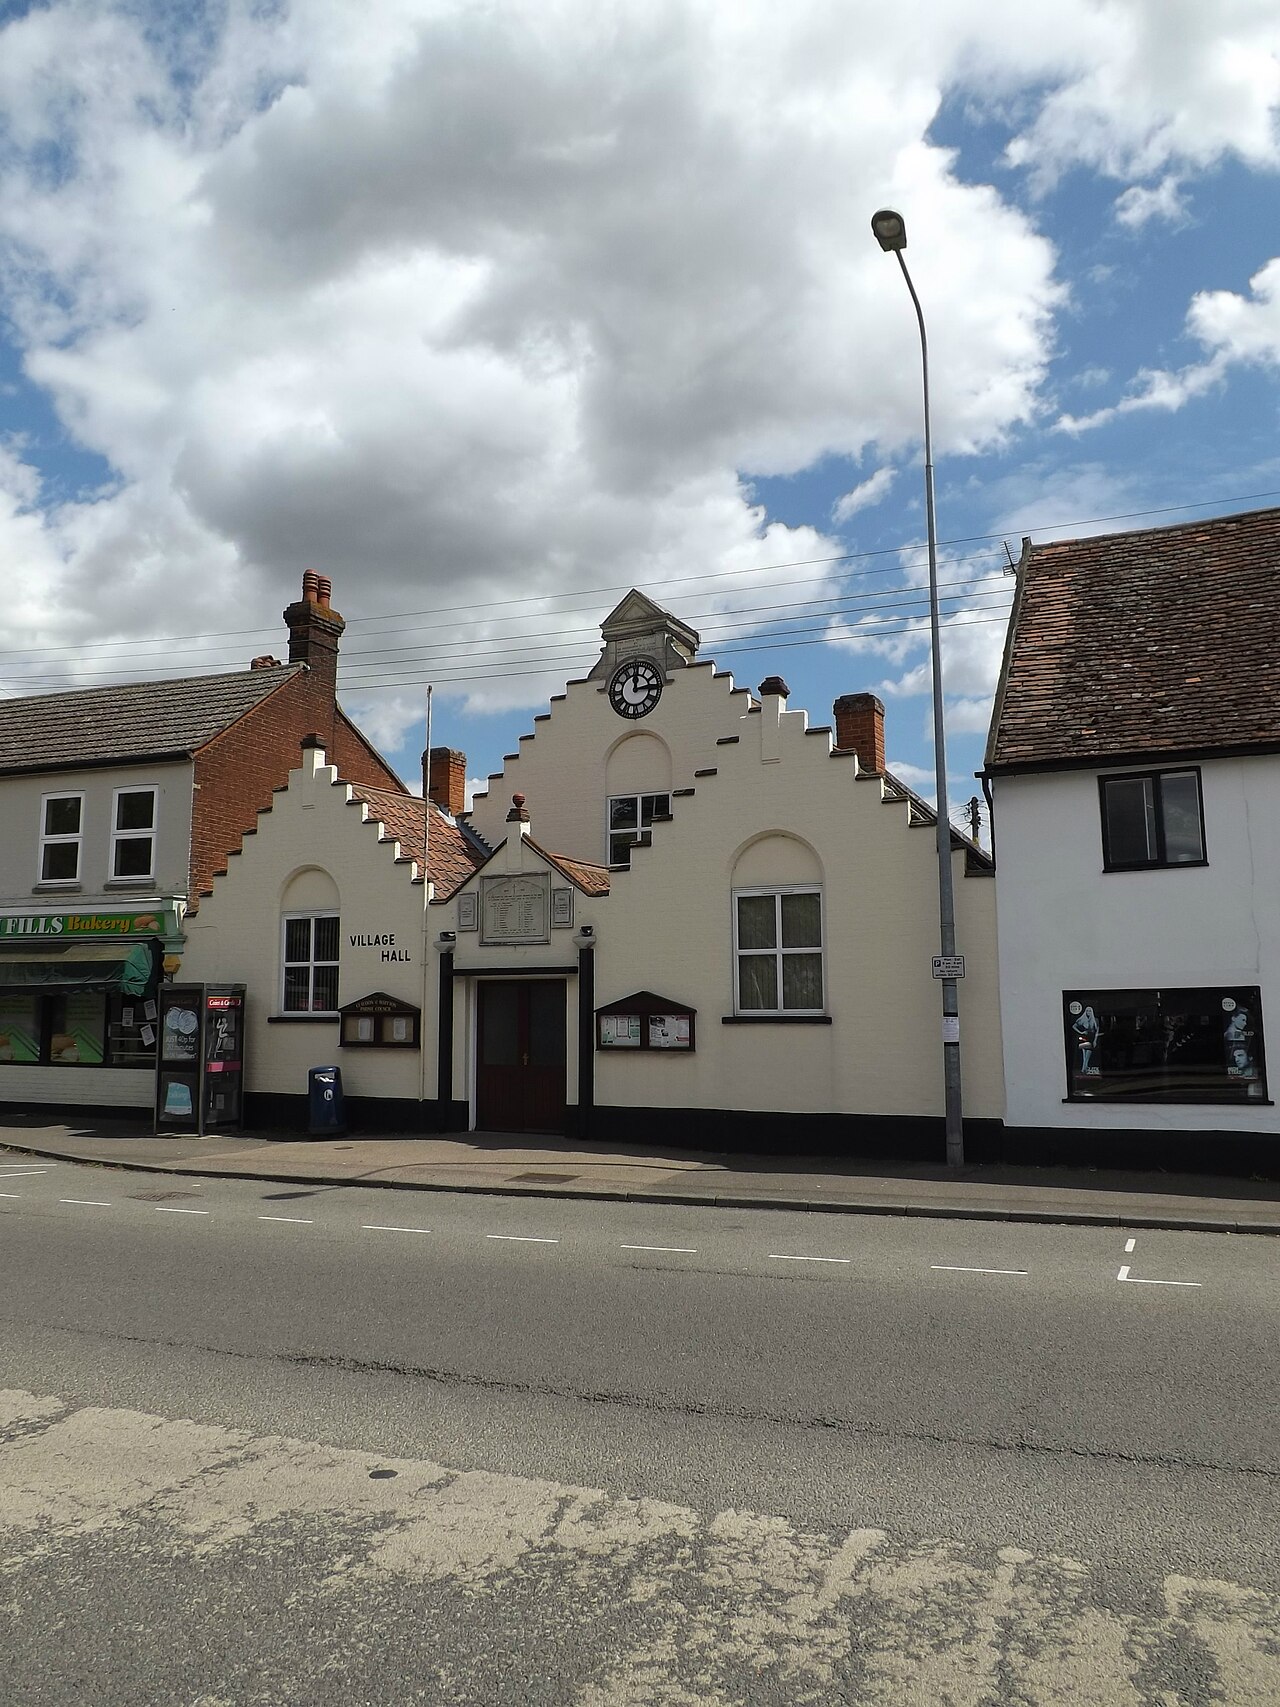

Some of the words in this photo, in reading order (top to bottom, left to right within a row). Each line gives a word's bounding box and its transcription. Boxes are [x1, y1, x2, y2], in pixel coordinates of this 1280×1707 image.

[5, 916, 63, 935] FILLS
[67, 915, 131, 934] Bakery
[349, 933, 395, 947] VILLAGE
[381, 949, 411, 962] HALL
